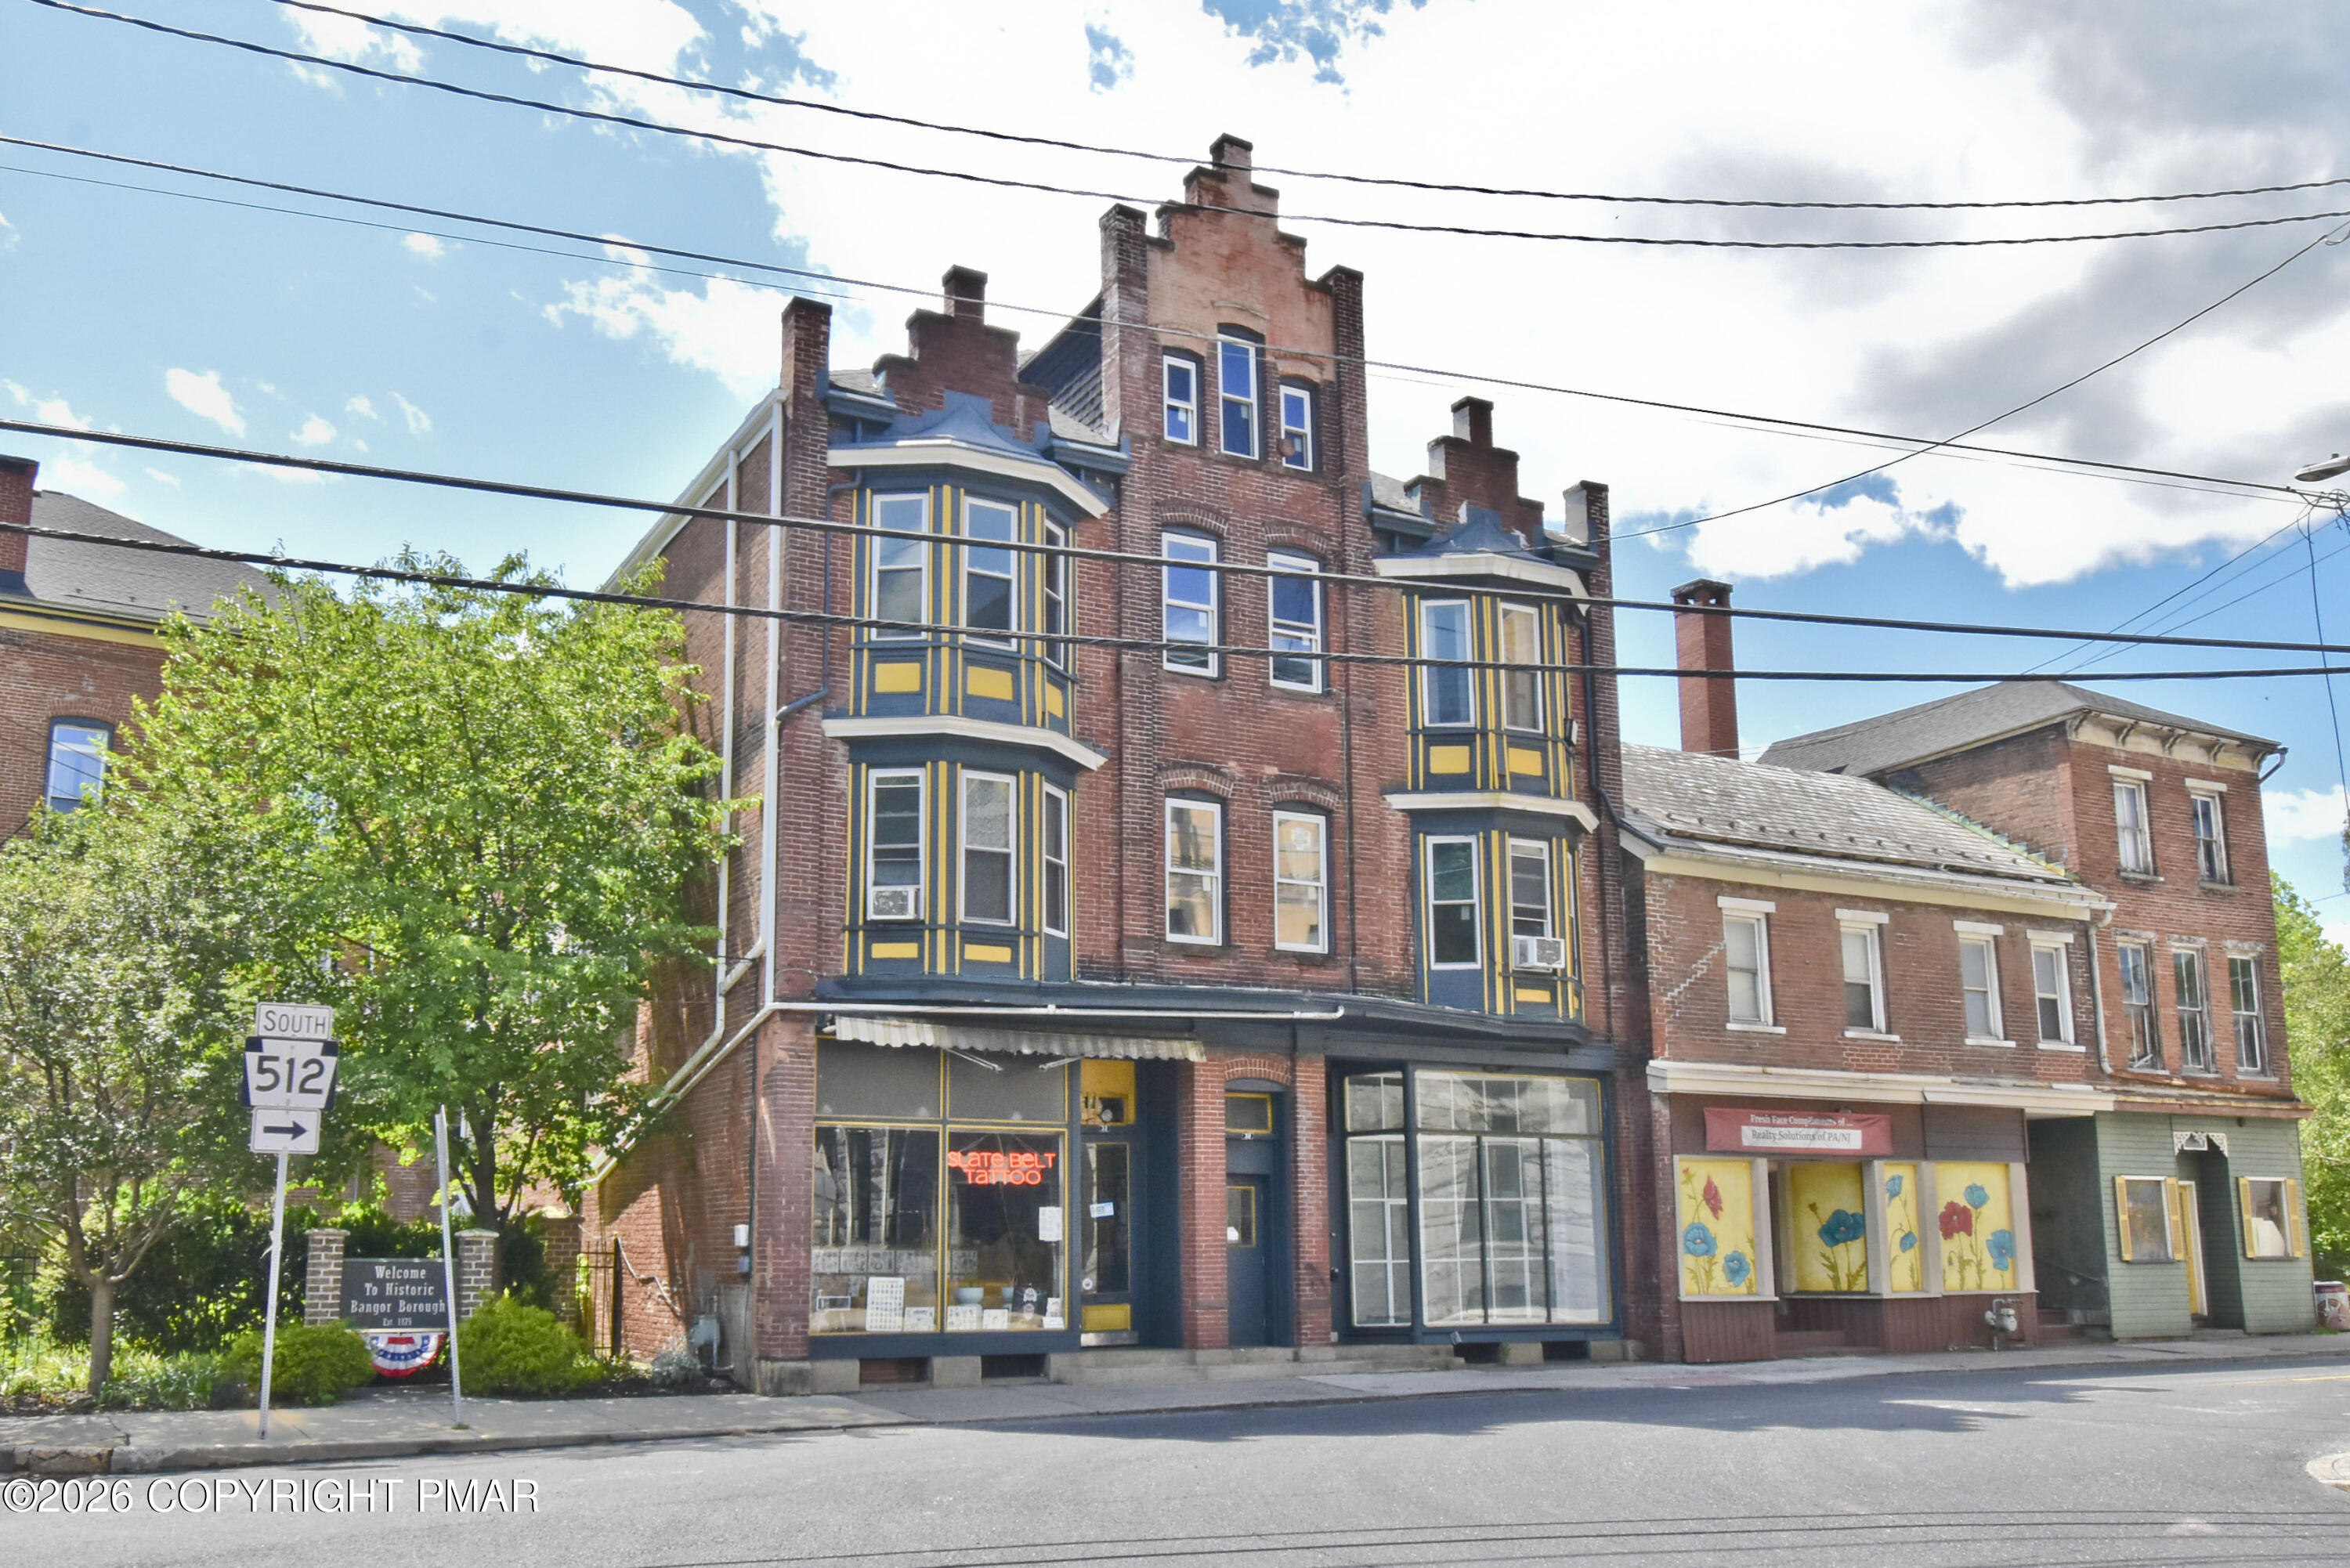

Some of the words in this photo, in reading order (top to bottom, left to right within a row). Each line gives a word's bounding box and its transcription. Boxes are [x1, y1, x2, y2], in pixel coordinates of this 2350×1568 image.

[264, 1010, 326, 1035] SOUTH
[255, 1055, 325, 1095] 512
[1750, 1114, 1771, 1123] Fresh
[1772, 1115, 1788, 1125] Face
[1752, 1129, 1777, 1142] Realty
[1778, 1130, 1816, 1141] Solutions
[1817, 1132, 1826, 1141] of
[374, 1266, 426, 1279] Welcome
[364, 1283, 378, 1296] To
[385, 1283, 435, 1296] Historic
[350, 1300, 392, 1315] Bangor
[398, 1300, 445, 1315] Borough
